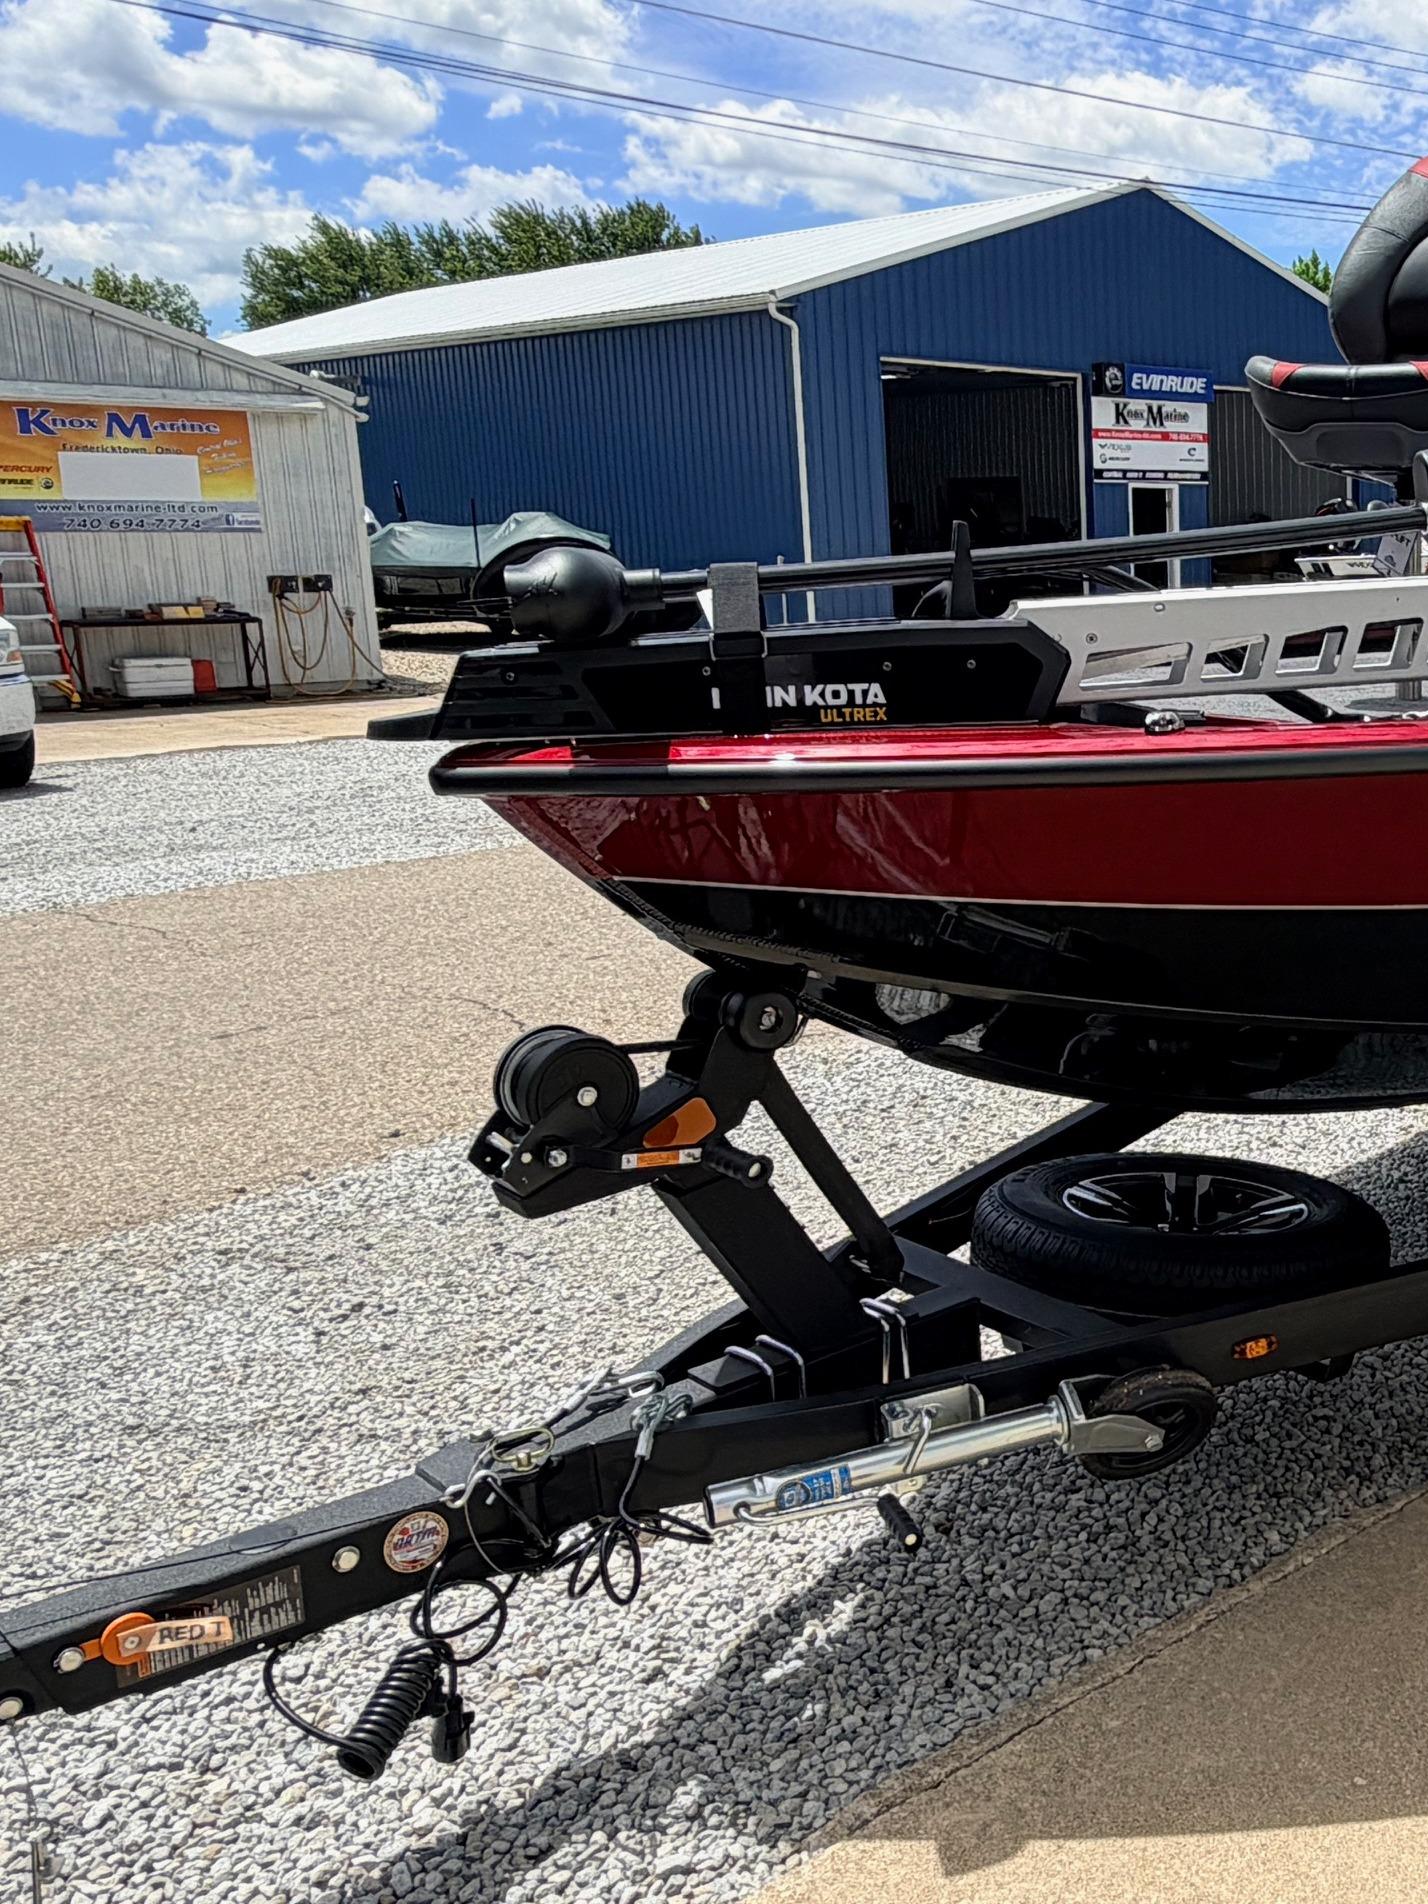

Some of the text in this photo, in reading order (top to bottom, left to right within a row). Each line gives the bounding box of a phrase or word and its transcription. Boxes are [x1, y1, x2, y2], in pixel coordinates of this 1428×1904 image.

[1131, 373, 1207, 394] EVINRUDE
[13, 406, 220, 440] Knox Marine
[1112, 400, 1190, 429] Knox Marine
[64, 517, 102, 530] 740
[109, 517, 146, 529] 694
[803, 682, 887, 706] KOTA
[819, 706, 888, 723] ULTREX
[158, 1623, 205, 1644] RED
